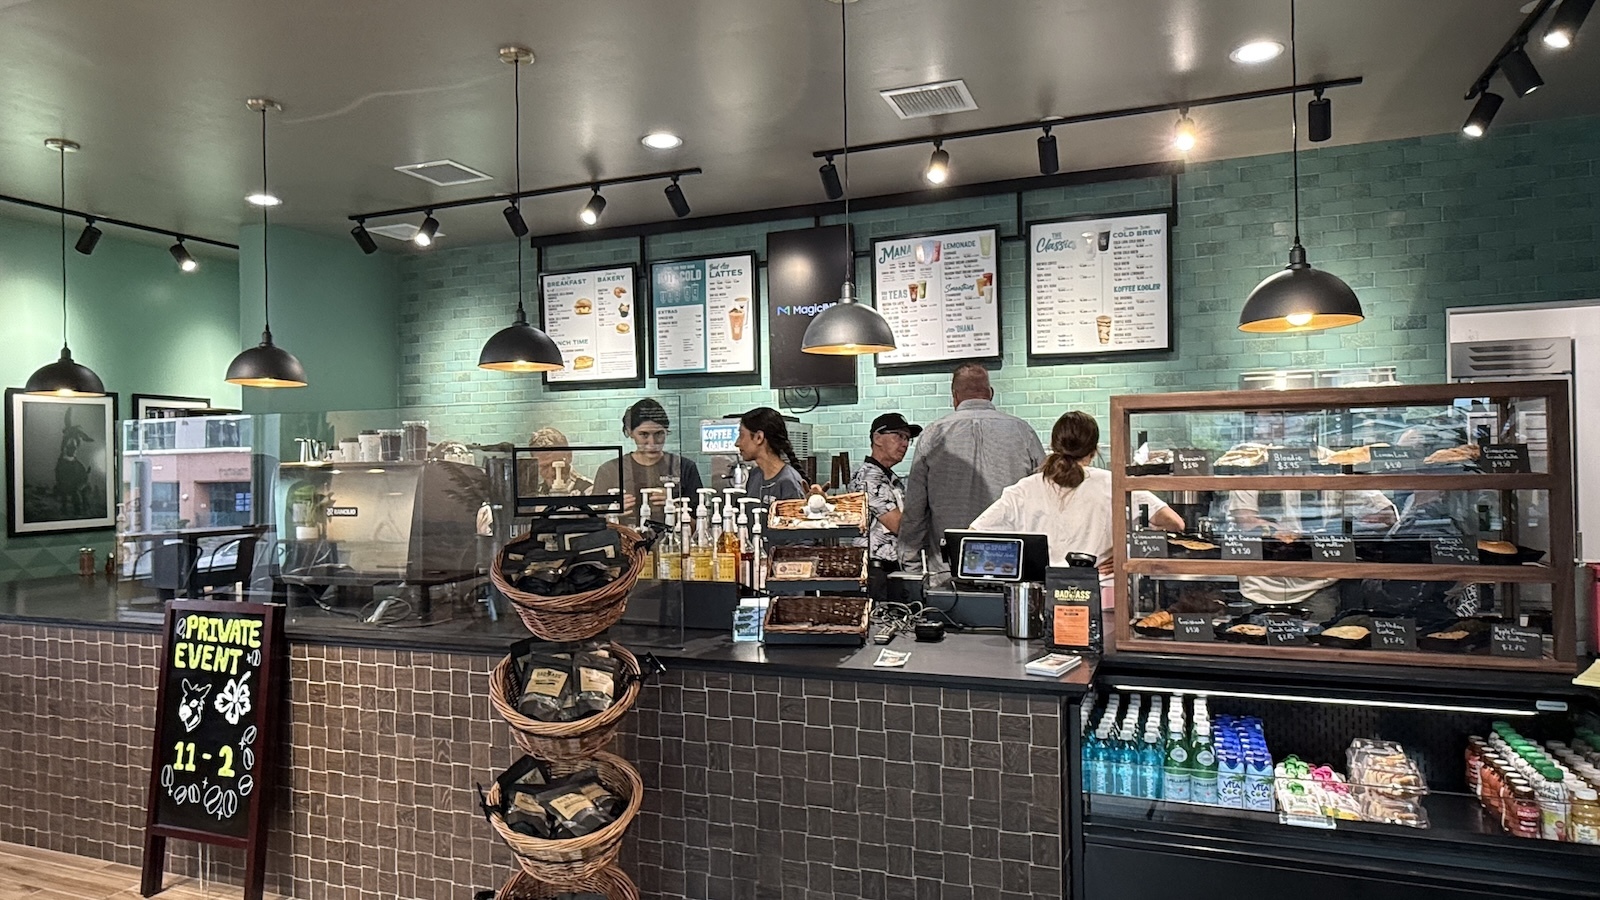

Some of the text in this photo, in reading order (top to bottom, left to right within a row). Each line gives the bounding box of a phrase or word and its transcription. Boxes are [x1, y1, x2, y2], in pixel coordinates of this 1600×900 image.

[1112, 231, 1135, 239] COLD
[943, 240, 976, 250] LEMONADE
[1036, 237, 1077, 253] Classics
[878, 244, 911, 264] MANA
[679, 269, 702, 282] COLD
[709, 268, 743, 279] LATTES
[546, 278, 588, 288] BREAKFAST
[597, 275, 626, 283] BAKERY
[1113, 283, 1161, 293] KOFFEE KOOLER
[888, 289, 908, 300] TEAS
[1273, 452, 1303, 462] Blondie
[1131, 532, 1165, 540] Cinnamon
[1054, 589, 1092, 600] BAD ASS
[186, 614, 263, 648] PRIVATE
[1374, 620, 1406, 633] Birthday
[1494, 626, 1511, 636] Apple
[174, 642, 244, 676] EVENT
[173, 741, 236, 778] 11 - 2
[1223, 780, 1241, 789] VITA
[1251, 783, 1270, 792] VITA
[1250, 790, 1272, 799] COCO
